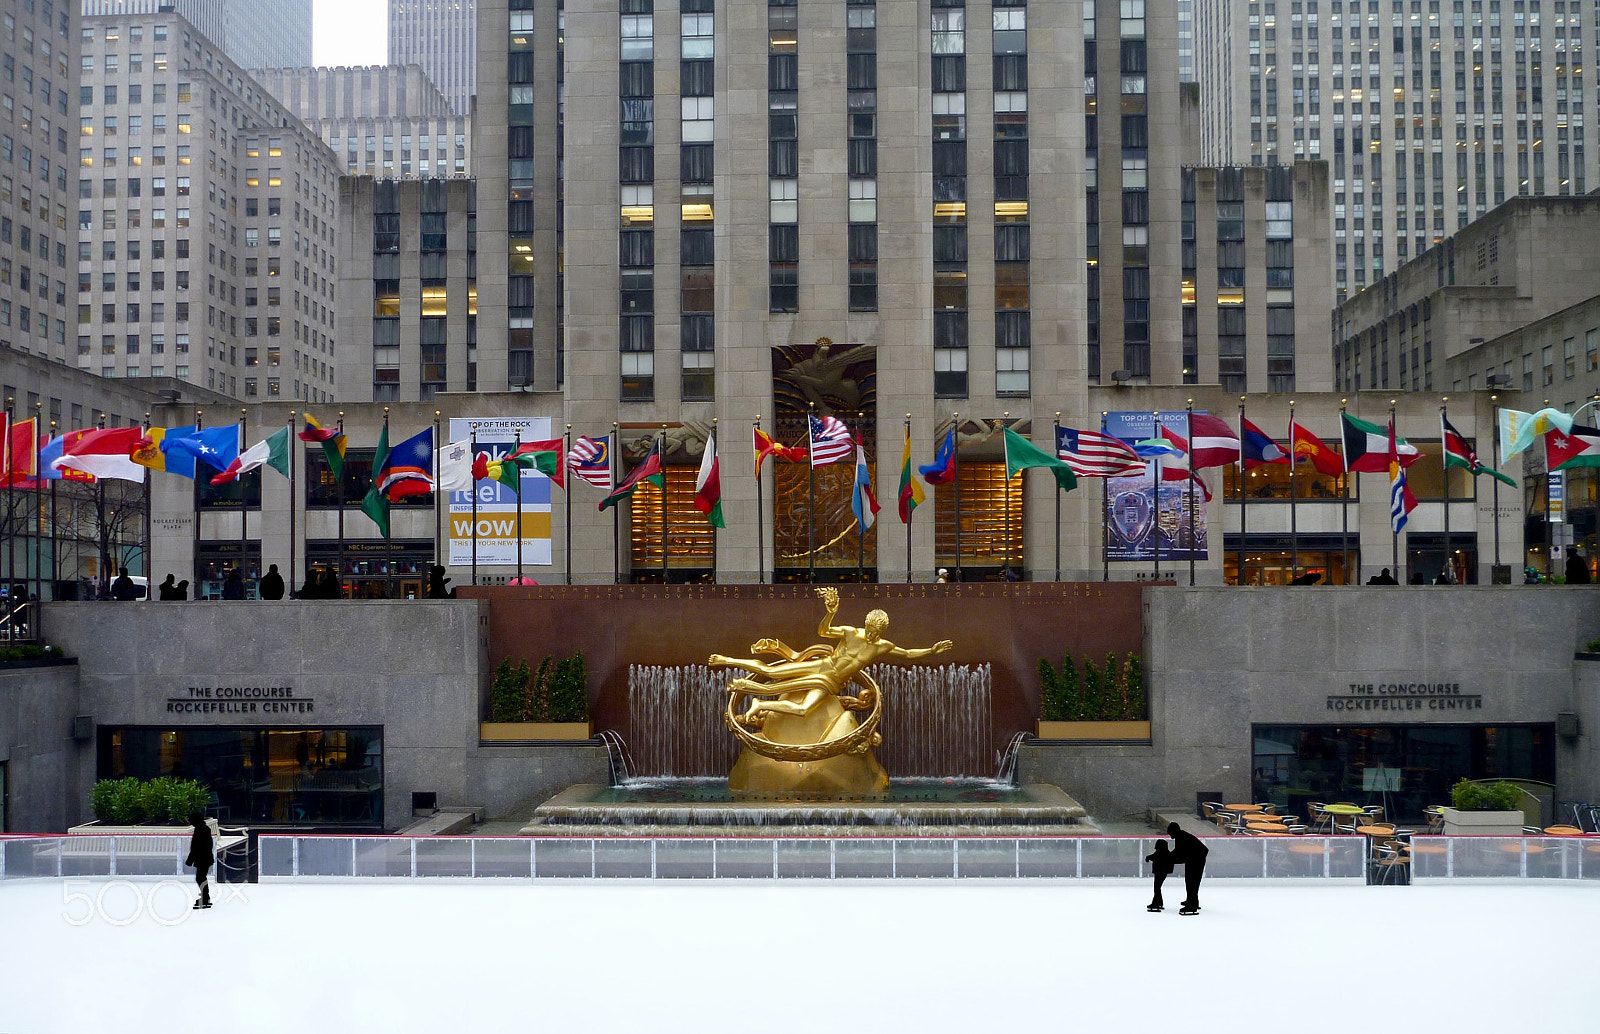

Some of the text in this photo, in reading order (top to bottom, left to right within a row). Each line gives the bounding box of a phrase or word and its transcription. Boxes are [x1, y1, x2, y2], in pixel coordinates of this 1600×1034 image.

[454, 520, 515, 536] WOW
[188, 688, 292, 698] THE CONCOURSE
[1350, 684, 1460, 694] THE CONCOURSE
[167, 702, 314, 713] ROCKEFELLER CENTER
[1326, 699, 1482, 711] ROCKEFELLER CENTER
